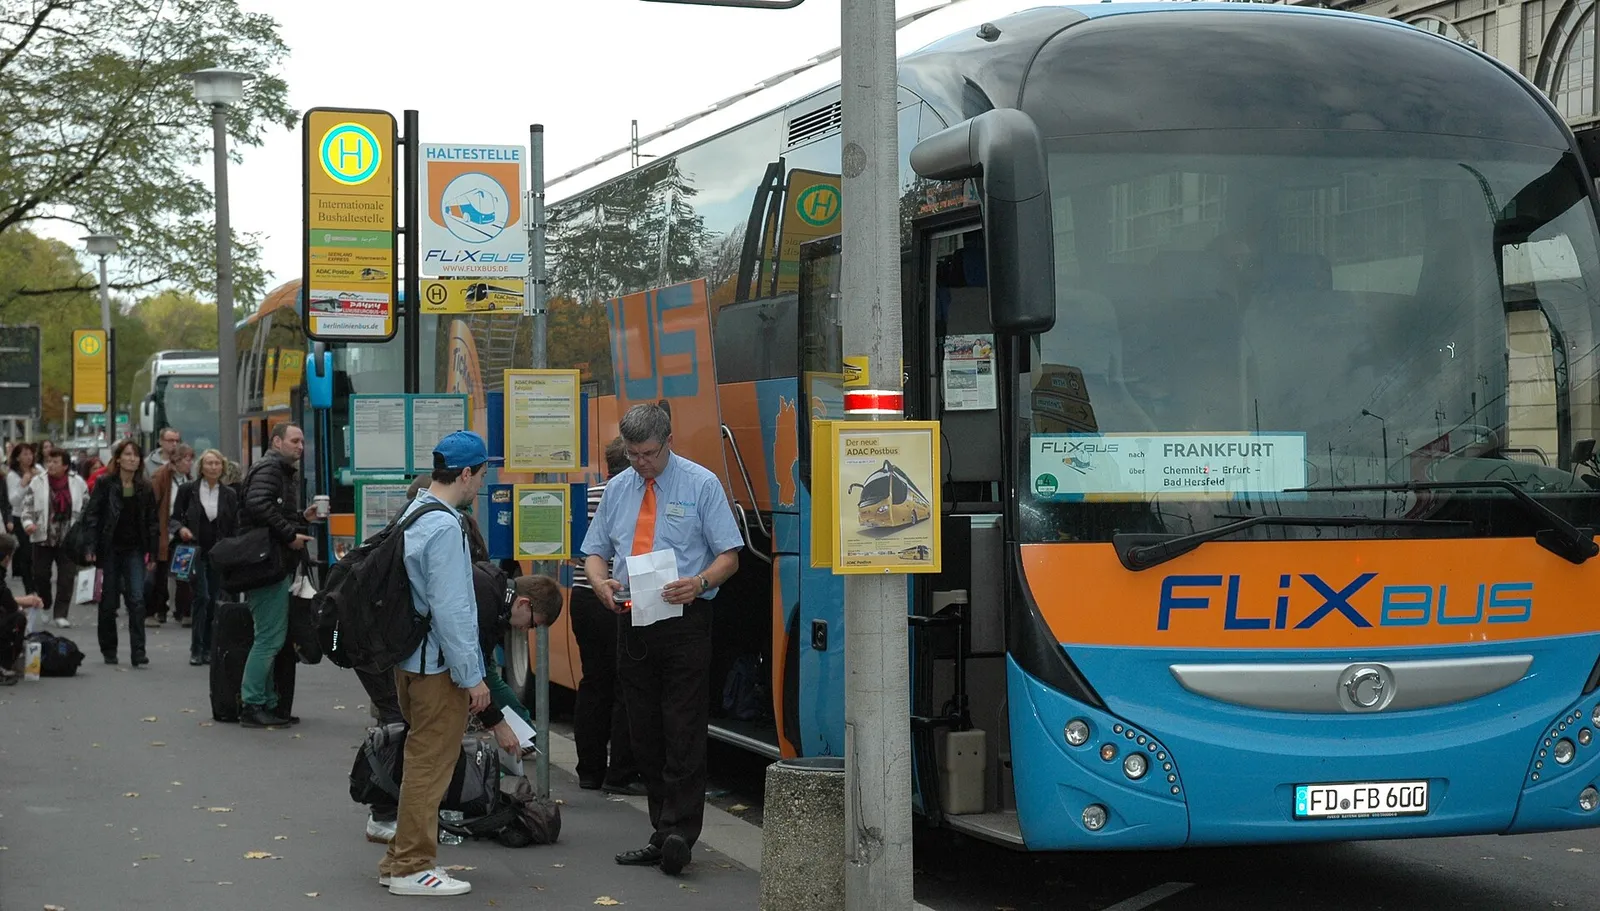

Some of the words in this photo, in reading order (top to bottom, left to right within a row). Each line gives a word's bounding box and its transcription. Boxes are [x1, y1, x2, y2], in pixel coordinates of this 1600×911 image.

[339, 138, 362, 169] H
[426, 148, 519, 160] HALTESTELLE
[318, 199, 384, 210] Internationale
[318, 212, 384, 223] Bushaltestelle
[323, 322, 379, 330] berlinlinienbus.de
[870, 447, 898, 455] Postbus
[1163, 443, 1274, 457] FRANKFURT
[1163, 466, 1209, 474] Chemnitz
[1222, 466, 1251, 474] Erfurt
[1163, 478, 1182, 486] Bad
[1184, 477, 1225, 486] Hersfeld
[1156, 572, 1534, 631] FLiXBUS
[1311, 789, 1338, 811] FD
[1353, 788, 1380, 810] FB
[1386, 786, 1425, 808] 600
